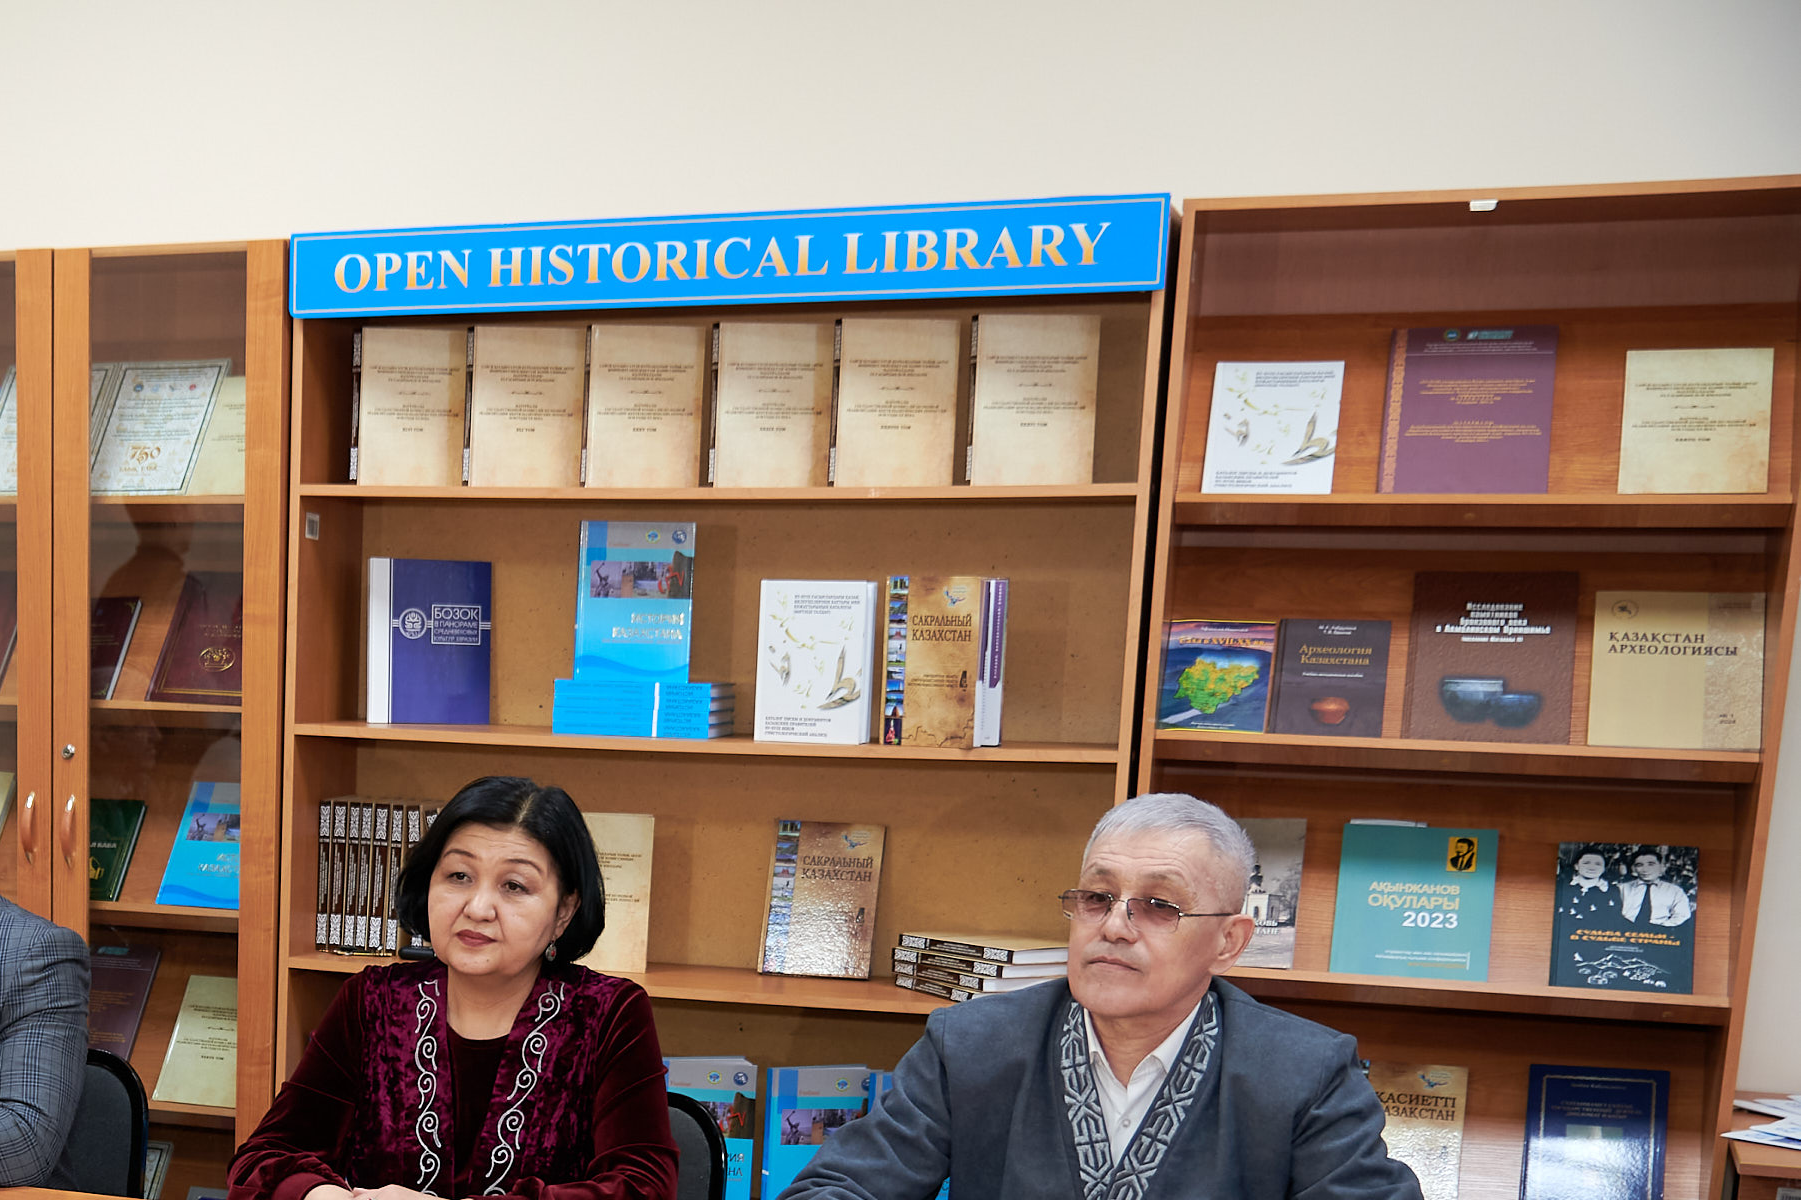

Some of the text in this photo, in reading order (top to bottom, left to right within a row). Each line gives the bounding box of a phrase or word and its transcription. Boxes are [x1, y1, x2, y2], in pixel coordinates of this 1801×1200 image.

[334, 222, 1111, 293] OPEN HISTORICAL LIBRARY
[434, 608, 478, 620] БОЗОК
[631, 612, 685, 626] ИСТОРИЯ
[912, 614, 972, 626] САКРАЛЬНЫЙ
[612, 626, 683, 640] КАЗАХСТАНА
[912, 629, 972, 642] КАЗАХСТАН
[1608, 631, 1705, 644] ҚАЗАҚСТАН
[1299, 644, 1373, 657] Археология
[1608, 644, 1738, 656] АРХЕОЛОГИЯСЫ
[1301, 654, 1370, 665] Казахстана
[803, 855, 874, 868] САКРАЛЬНЫЙ
[802, 868, 872, 882] КАЗАХСТАН
[1369, 881, 1460, 895] АҚЫНЖАНОВ
[1368, 893, 1460, 910] ОҚУЛАРЫ
[1402, 911, 1458, 929] 2023
[1630, 938, 1680, 946] СТРАНЫ
[1384, 1106, 1455, 1121] АЗАҚСТАН
[727, 1152, 744, 1163] ИЯ
[727, 1168, 743, 1176] НА
